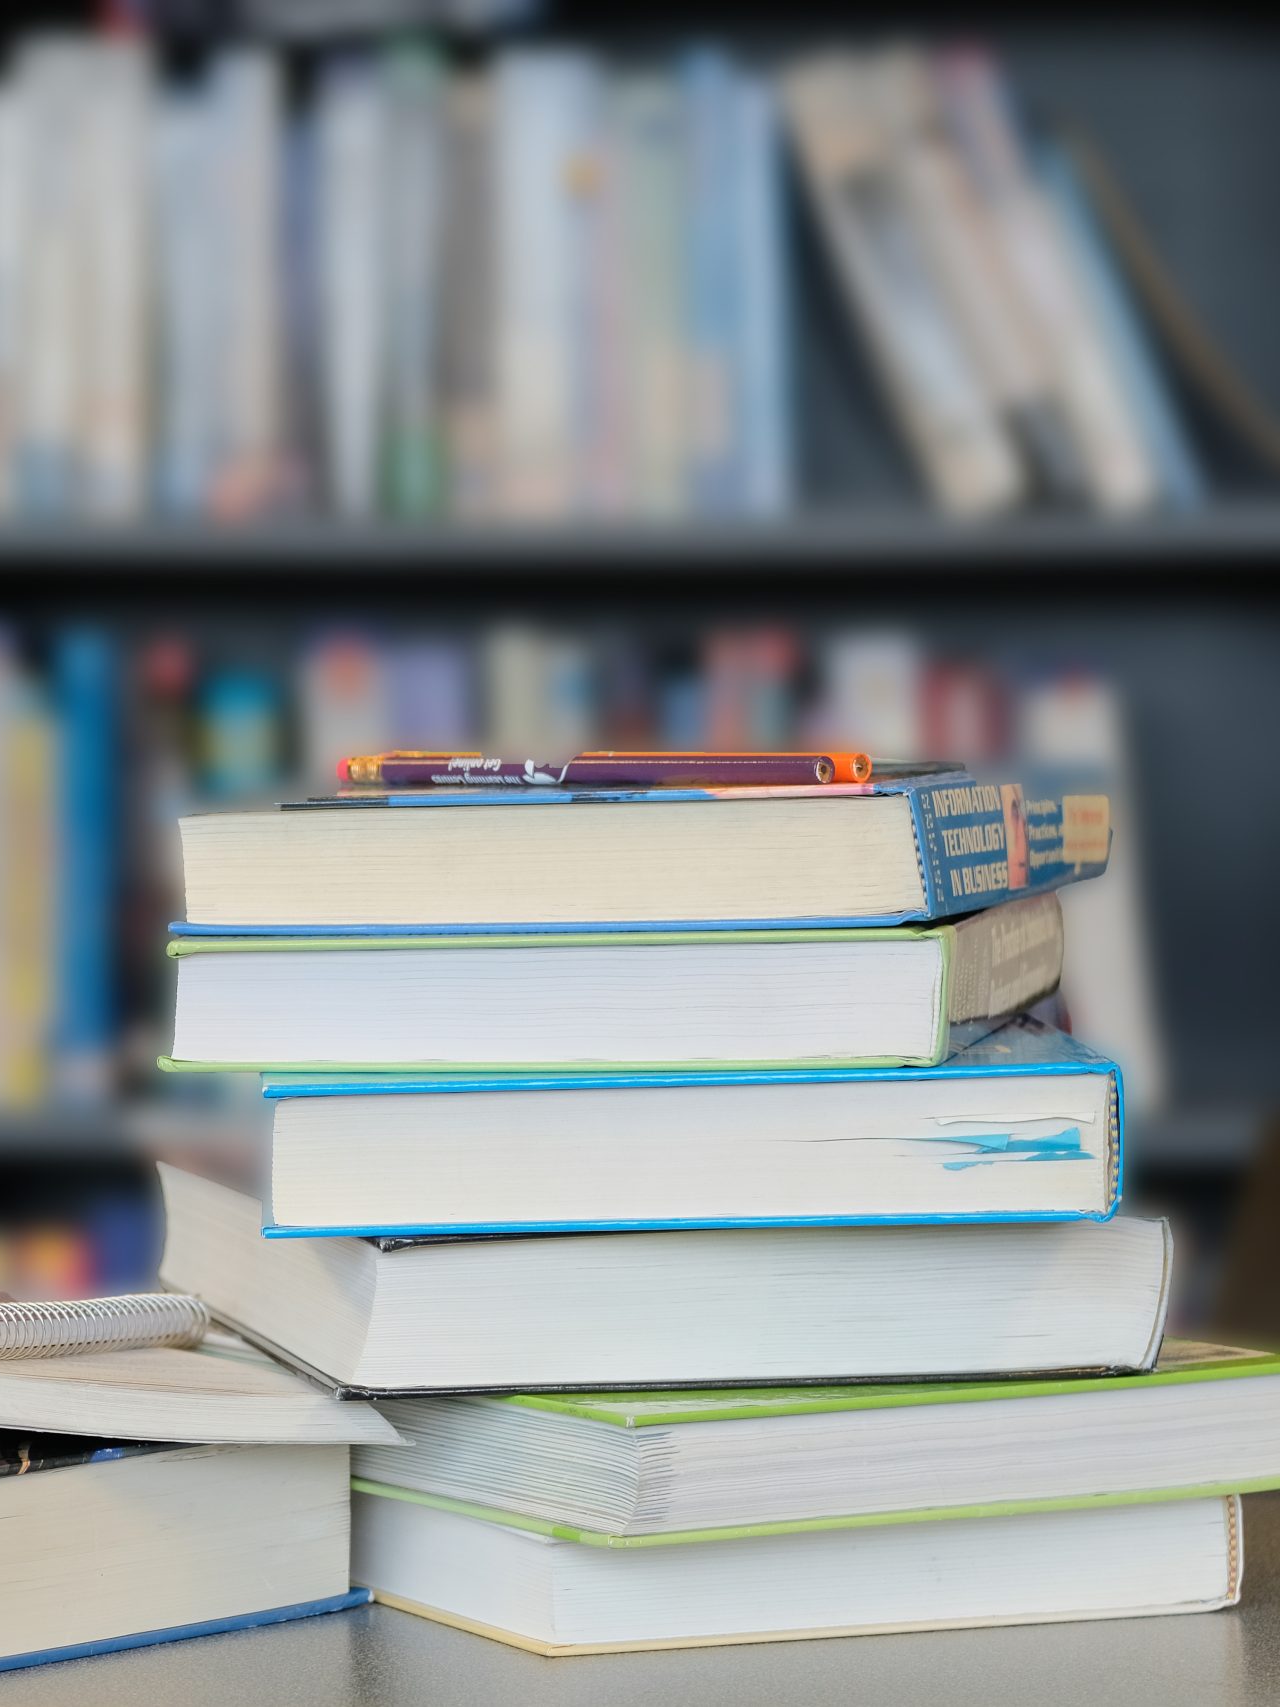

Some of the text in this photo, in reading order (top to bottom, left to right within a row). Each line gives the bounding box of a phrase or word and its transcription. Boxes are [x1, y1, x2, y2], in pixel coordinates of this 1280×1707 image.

[932, 785, 1001, 818] INFORMATION
[942, 824, 1005, 857] TECHNOLOGY
[950, 861, 1009, 897] IN BUSINESS
